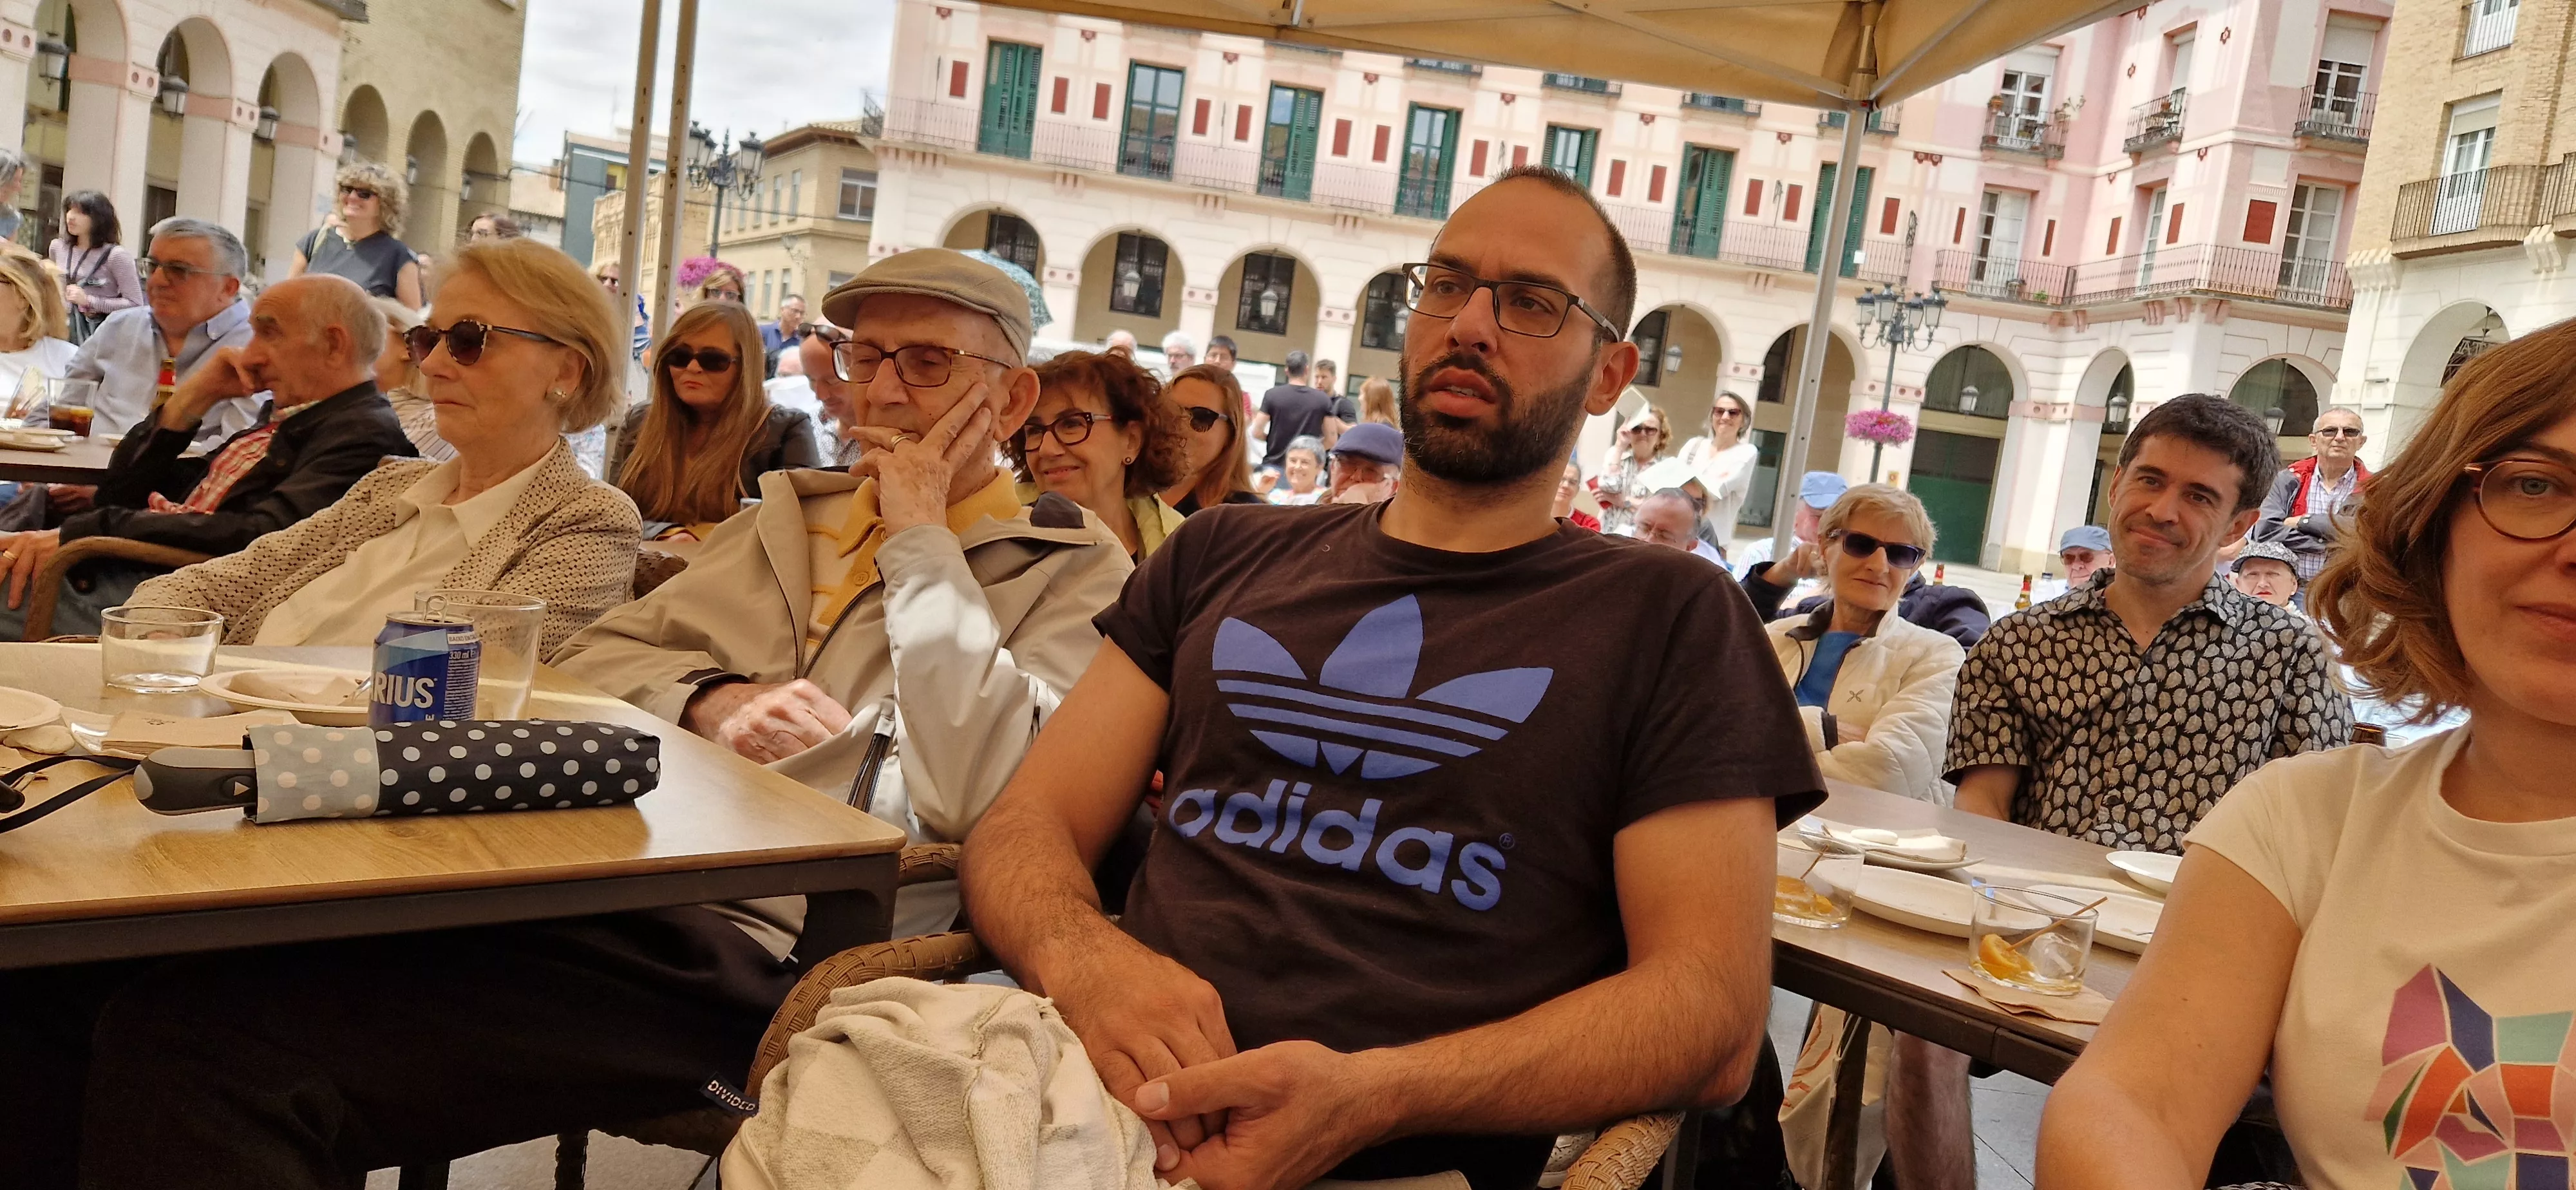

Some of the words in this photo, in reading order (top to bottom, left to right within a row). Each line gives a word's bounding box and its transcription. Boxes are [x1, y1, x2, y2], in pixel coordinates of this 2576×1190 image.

[449, 651, 461, 659] 330
[1168, 779, 1506, 911] adidas
[707, 1080, 755, 1111] DIVIDED
